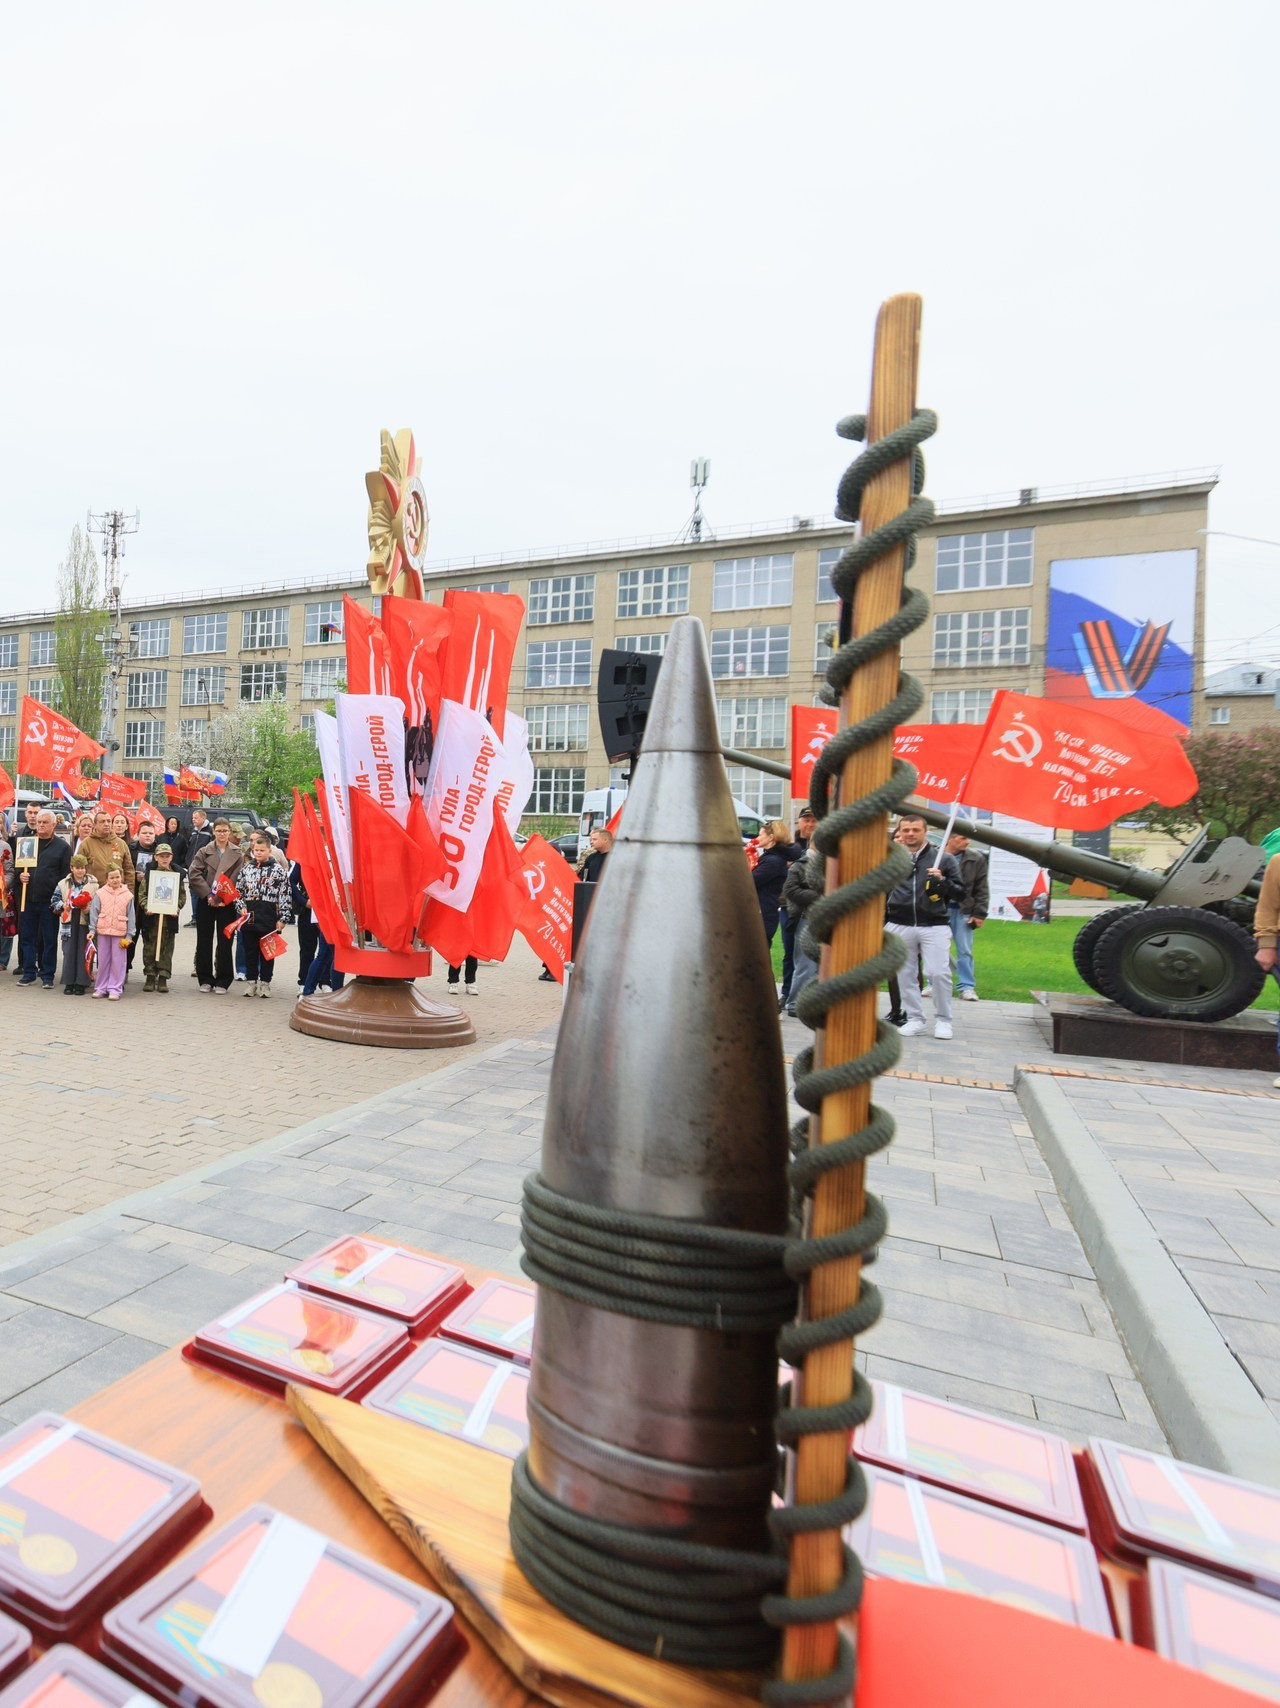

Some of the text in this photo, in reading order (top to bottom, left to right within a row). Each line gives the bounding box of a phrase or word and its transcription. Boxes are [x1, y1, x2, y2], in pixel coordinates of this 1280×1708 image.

[366, 715, 396, 809] ГОРОД-ГЕРОЙ
[1088, 743, 1132, 766] ОРДЕНА
[355, 774, 371, 794] ЛА
[458, 734, 497, 833] ГОРОД-ГЕРОЙ
[1053, 780, 1073, 803] 79
[537, 920, 554, 940] 79
